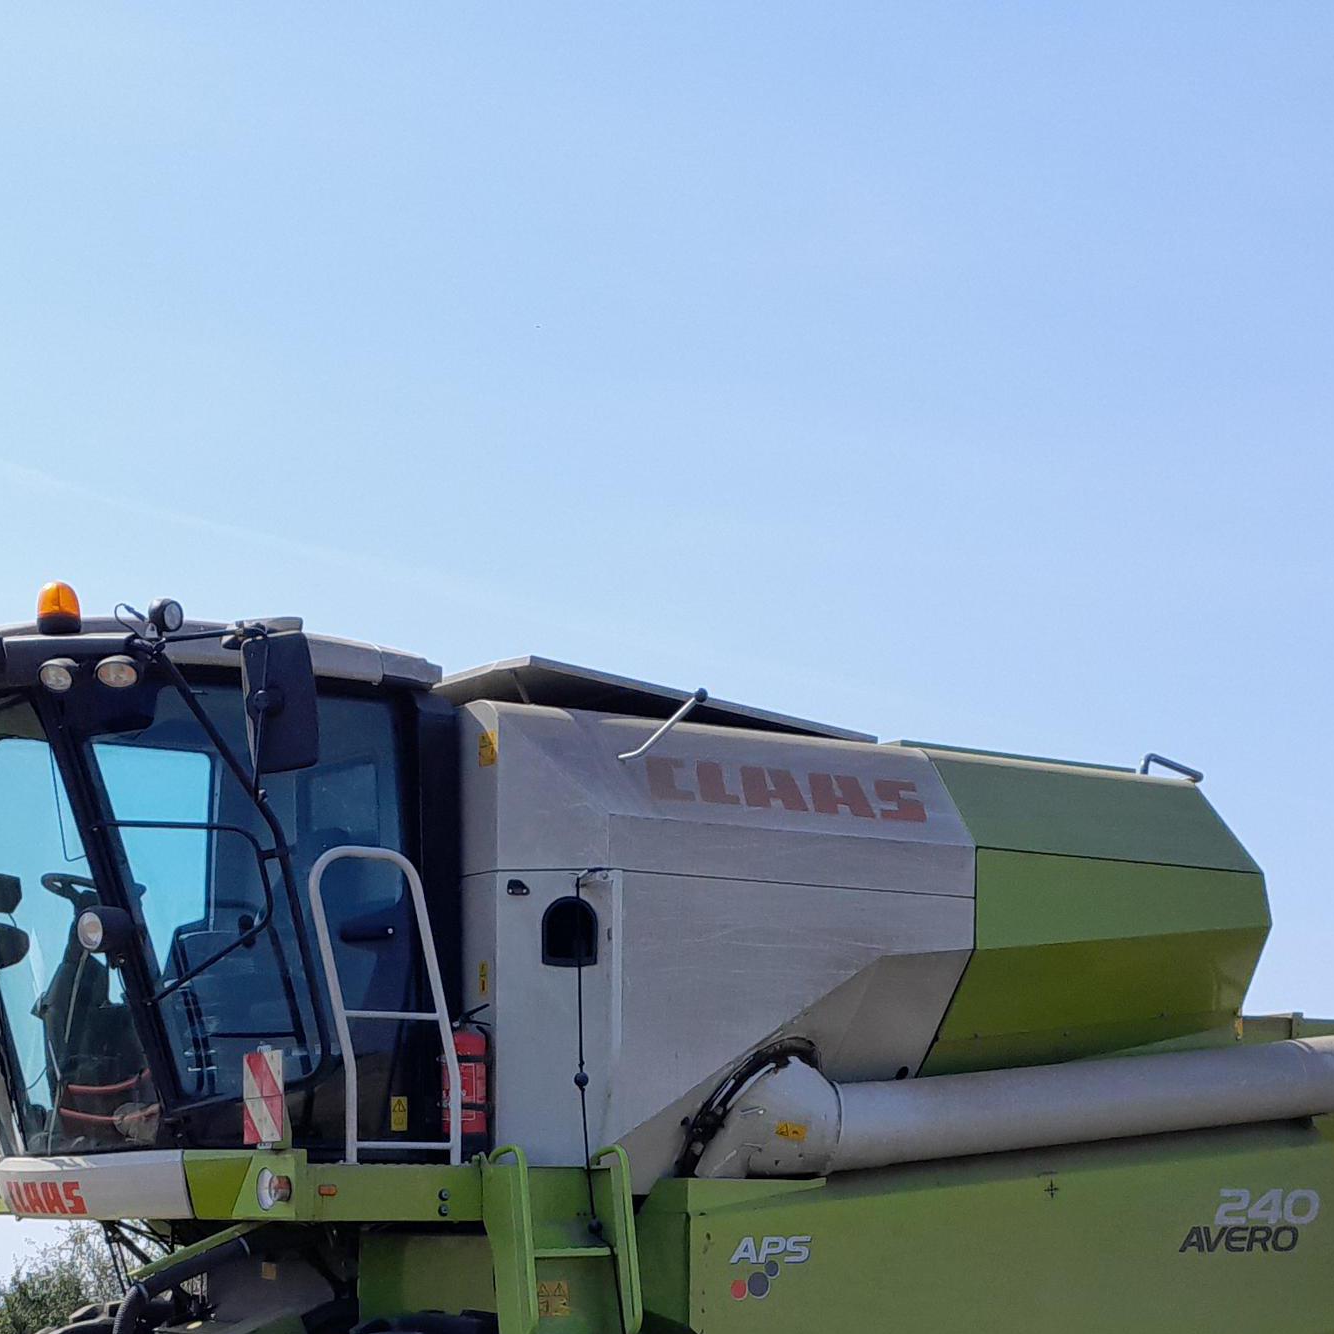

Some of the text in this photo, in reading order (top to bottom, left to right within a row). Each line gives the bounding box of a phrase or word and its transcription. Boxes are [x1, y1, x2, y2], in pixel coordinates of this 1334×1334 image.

[645, 756, 927, 823] CLAAS
[1214, 1188, 1320, 1225] 240
[729, 1235, 812, 1264] APS
[1178, 1226, 1299, 1252] AVERO
